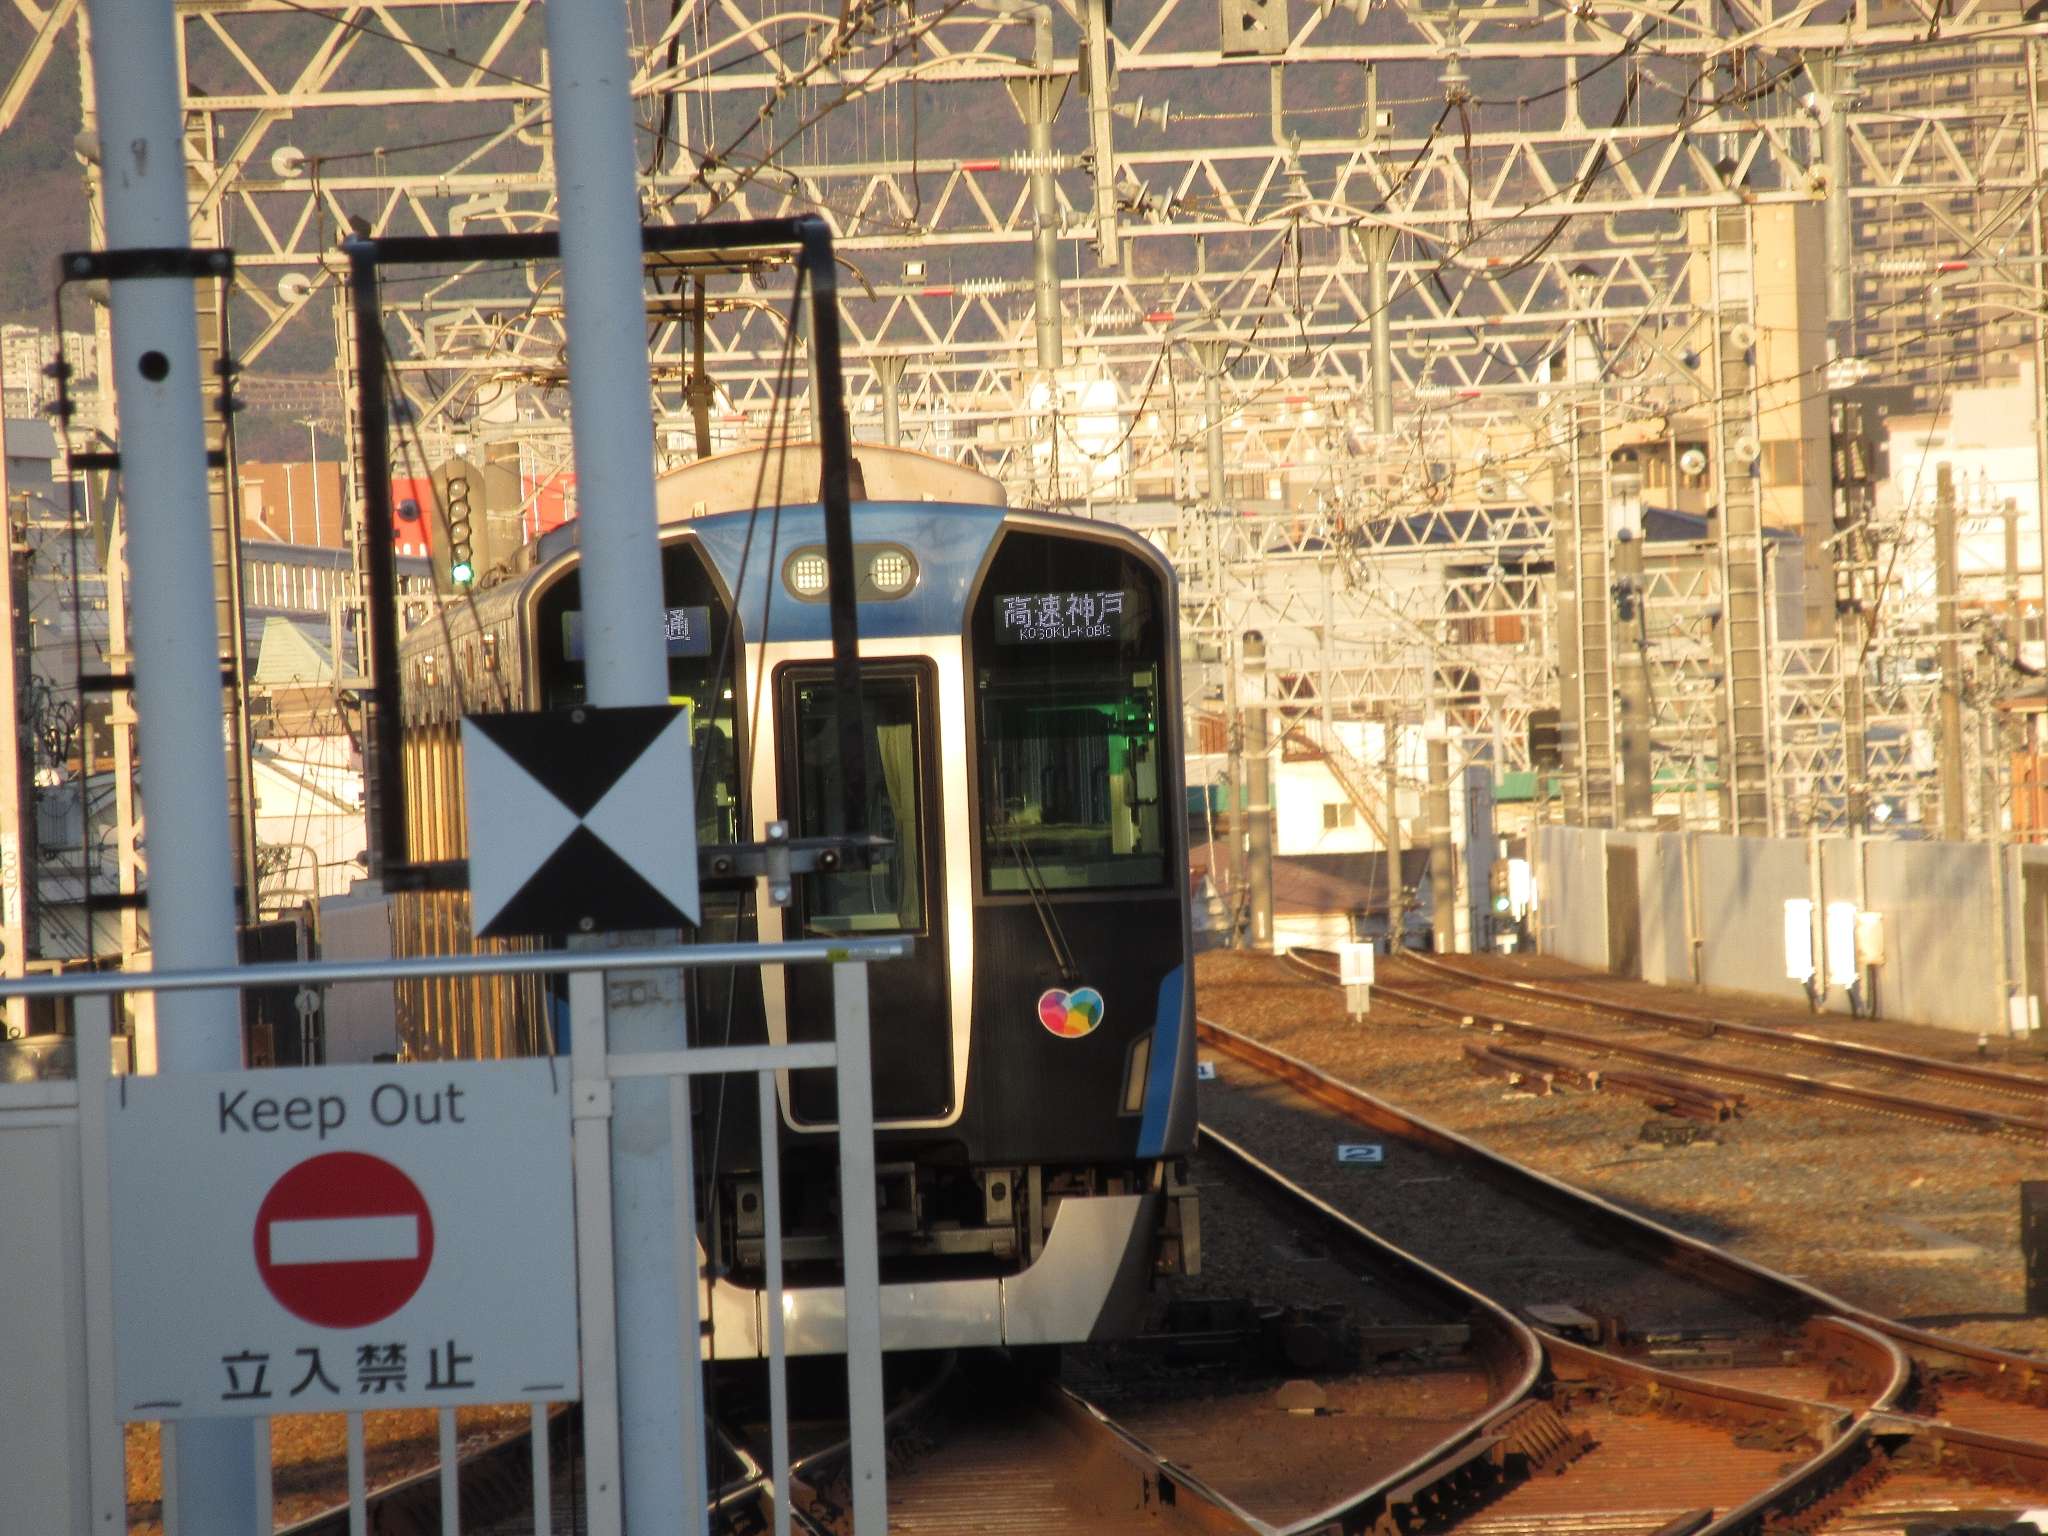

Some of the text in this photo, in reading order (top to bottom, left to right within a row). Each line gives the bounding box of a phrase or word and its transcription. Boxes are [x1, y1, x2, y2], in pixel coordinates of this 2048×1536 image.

[1003, 592, 1125, 628] 高速神戸
[1019, 624, 1113, 640] KOSOKU-KOBE
[219, 1082, 465, 1140] Keep Out
[1345, 1147, 1377, 1160] 2
[221, 1340, 475, 1401] 立入禁止
